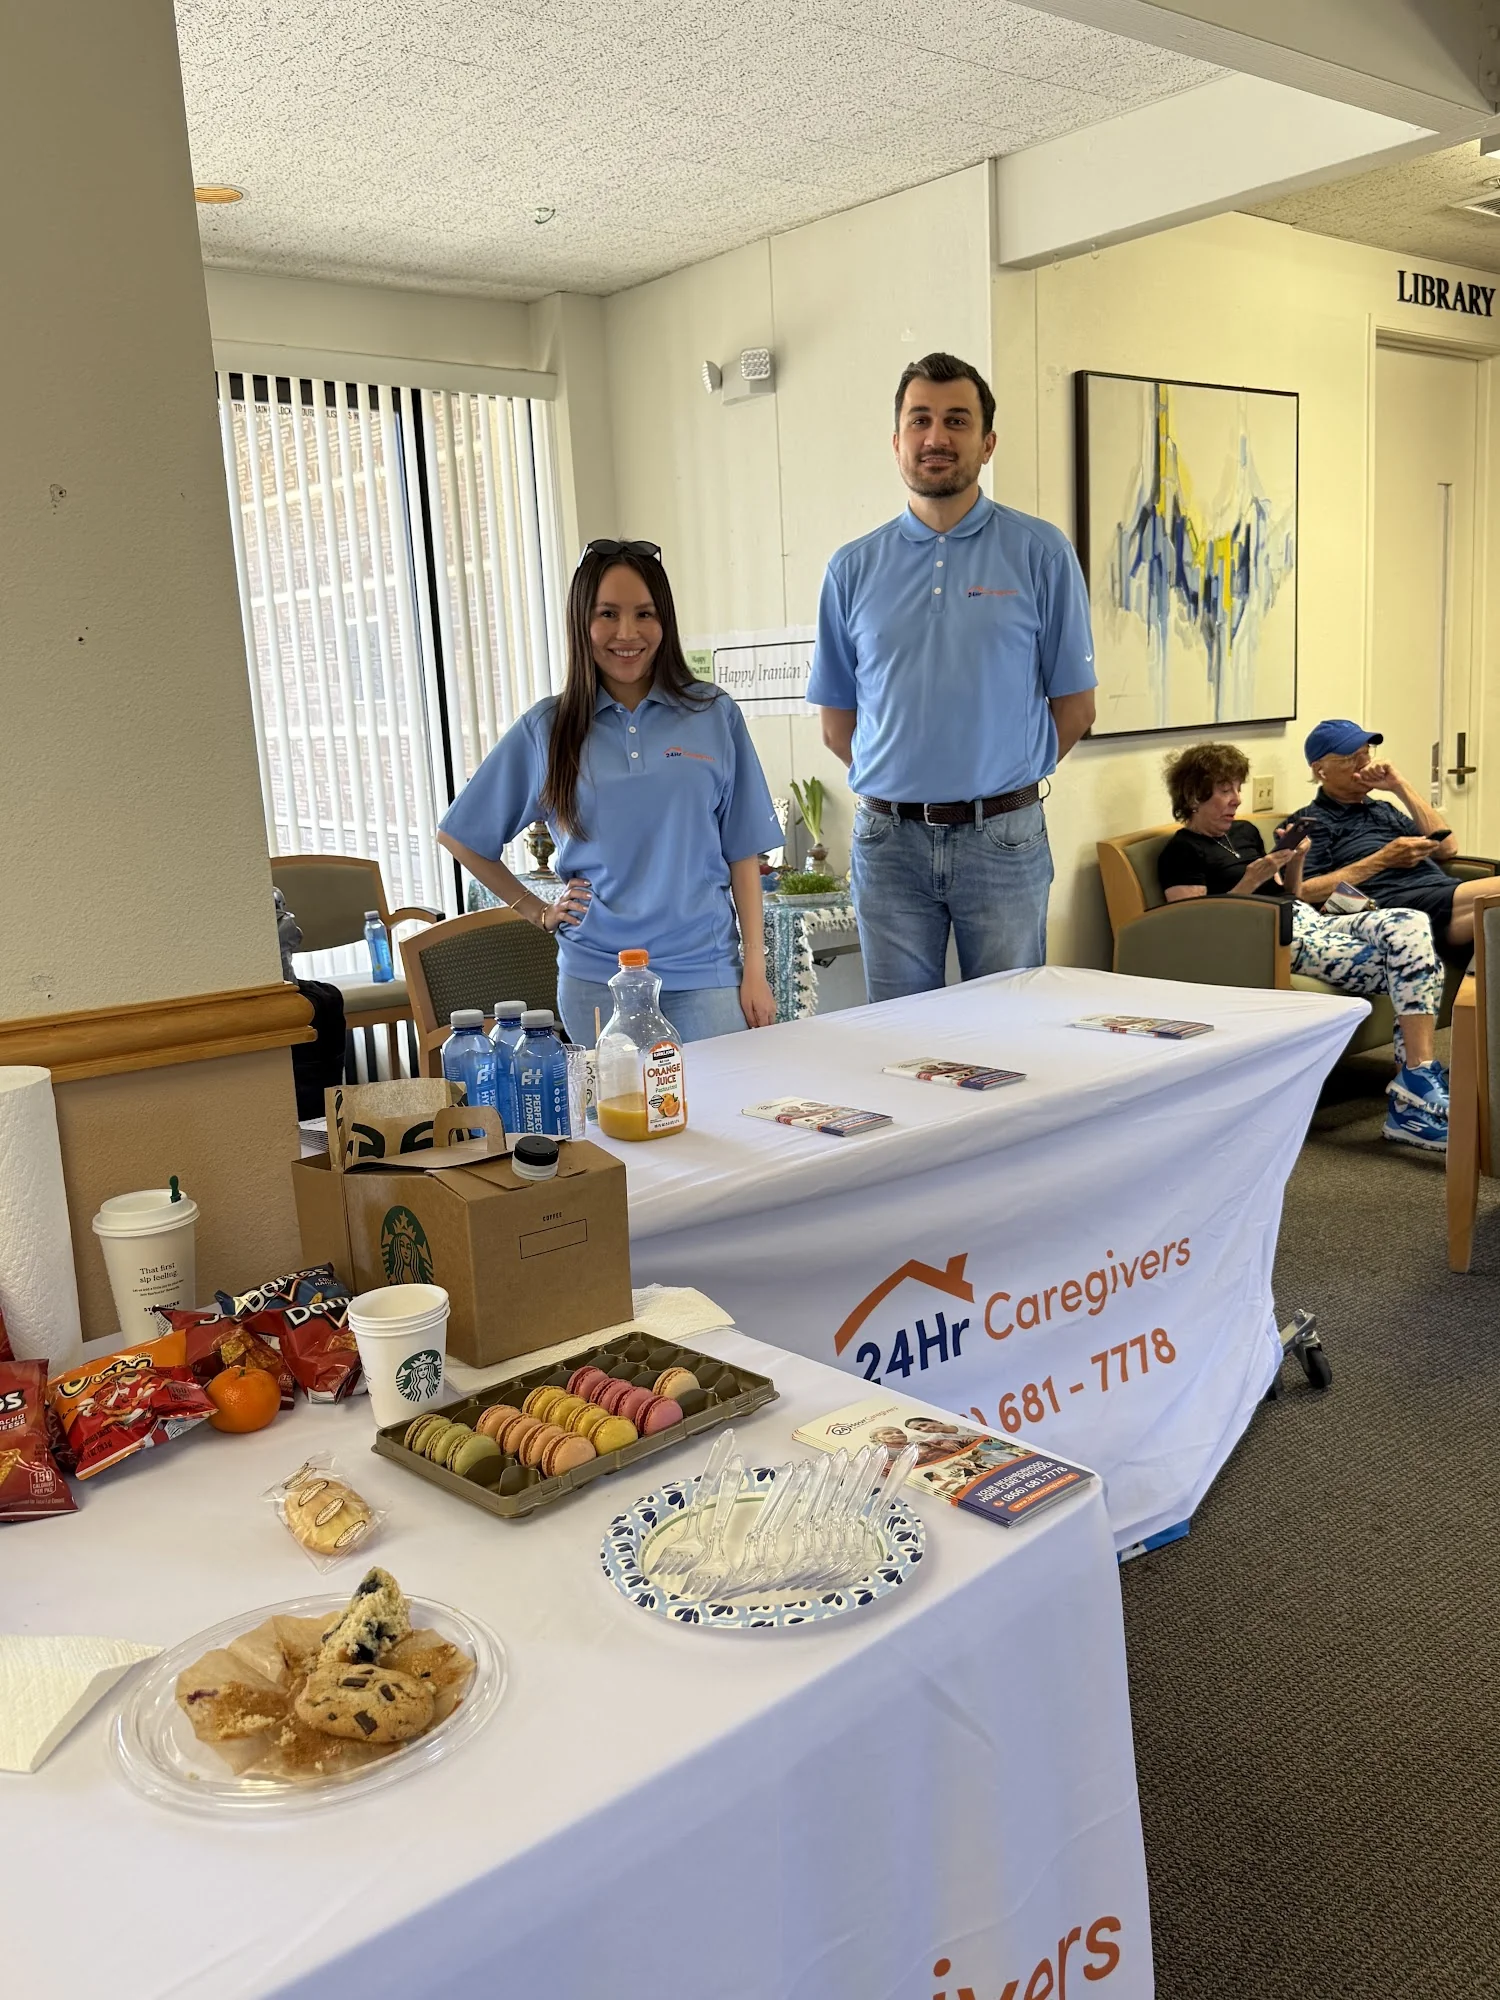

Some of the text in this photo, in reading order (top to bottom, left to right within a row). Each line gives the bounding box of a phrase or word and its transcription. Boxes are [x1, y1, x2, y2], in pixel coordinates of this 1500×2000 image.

[1397, 270, 1496, 317] LIBRARY
[718, 665, 756, 689] Happy
[758, 661, 801, 681] Iranian
[647, 1063, 681, 1078] ORANGE
[656, 1074, 677, 1087] JUICE
[524, 1093, 535, 1134] HYDRAT
[542, 1211, 563, 1222] COFFEE
[139, 1262, 176, 1275] That first
[139, 1276, 152, 1284] sip
[856, 1237, 1191, 1385] 24Hr Caregivers
[998, 1375, 1061, 1434] 681
[1090, 1327, 1176, 1393] 7778
[0, 1413, 25, 1426] ACHO
[33, 1469, 53, 1483] 150
[975, 1483, 997, 1497] YOUR
[978, 1488, 1004, 1503] HOME
[1000, 1477, 1022, 1492] CARE
[1001, 1466, 1068, 1502] (866) 681-7778
